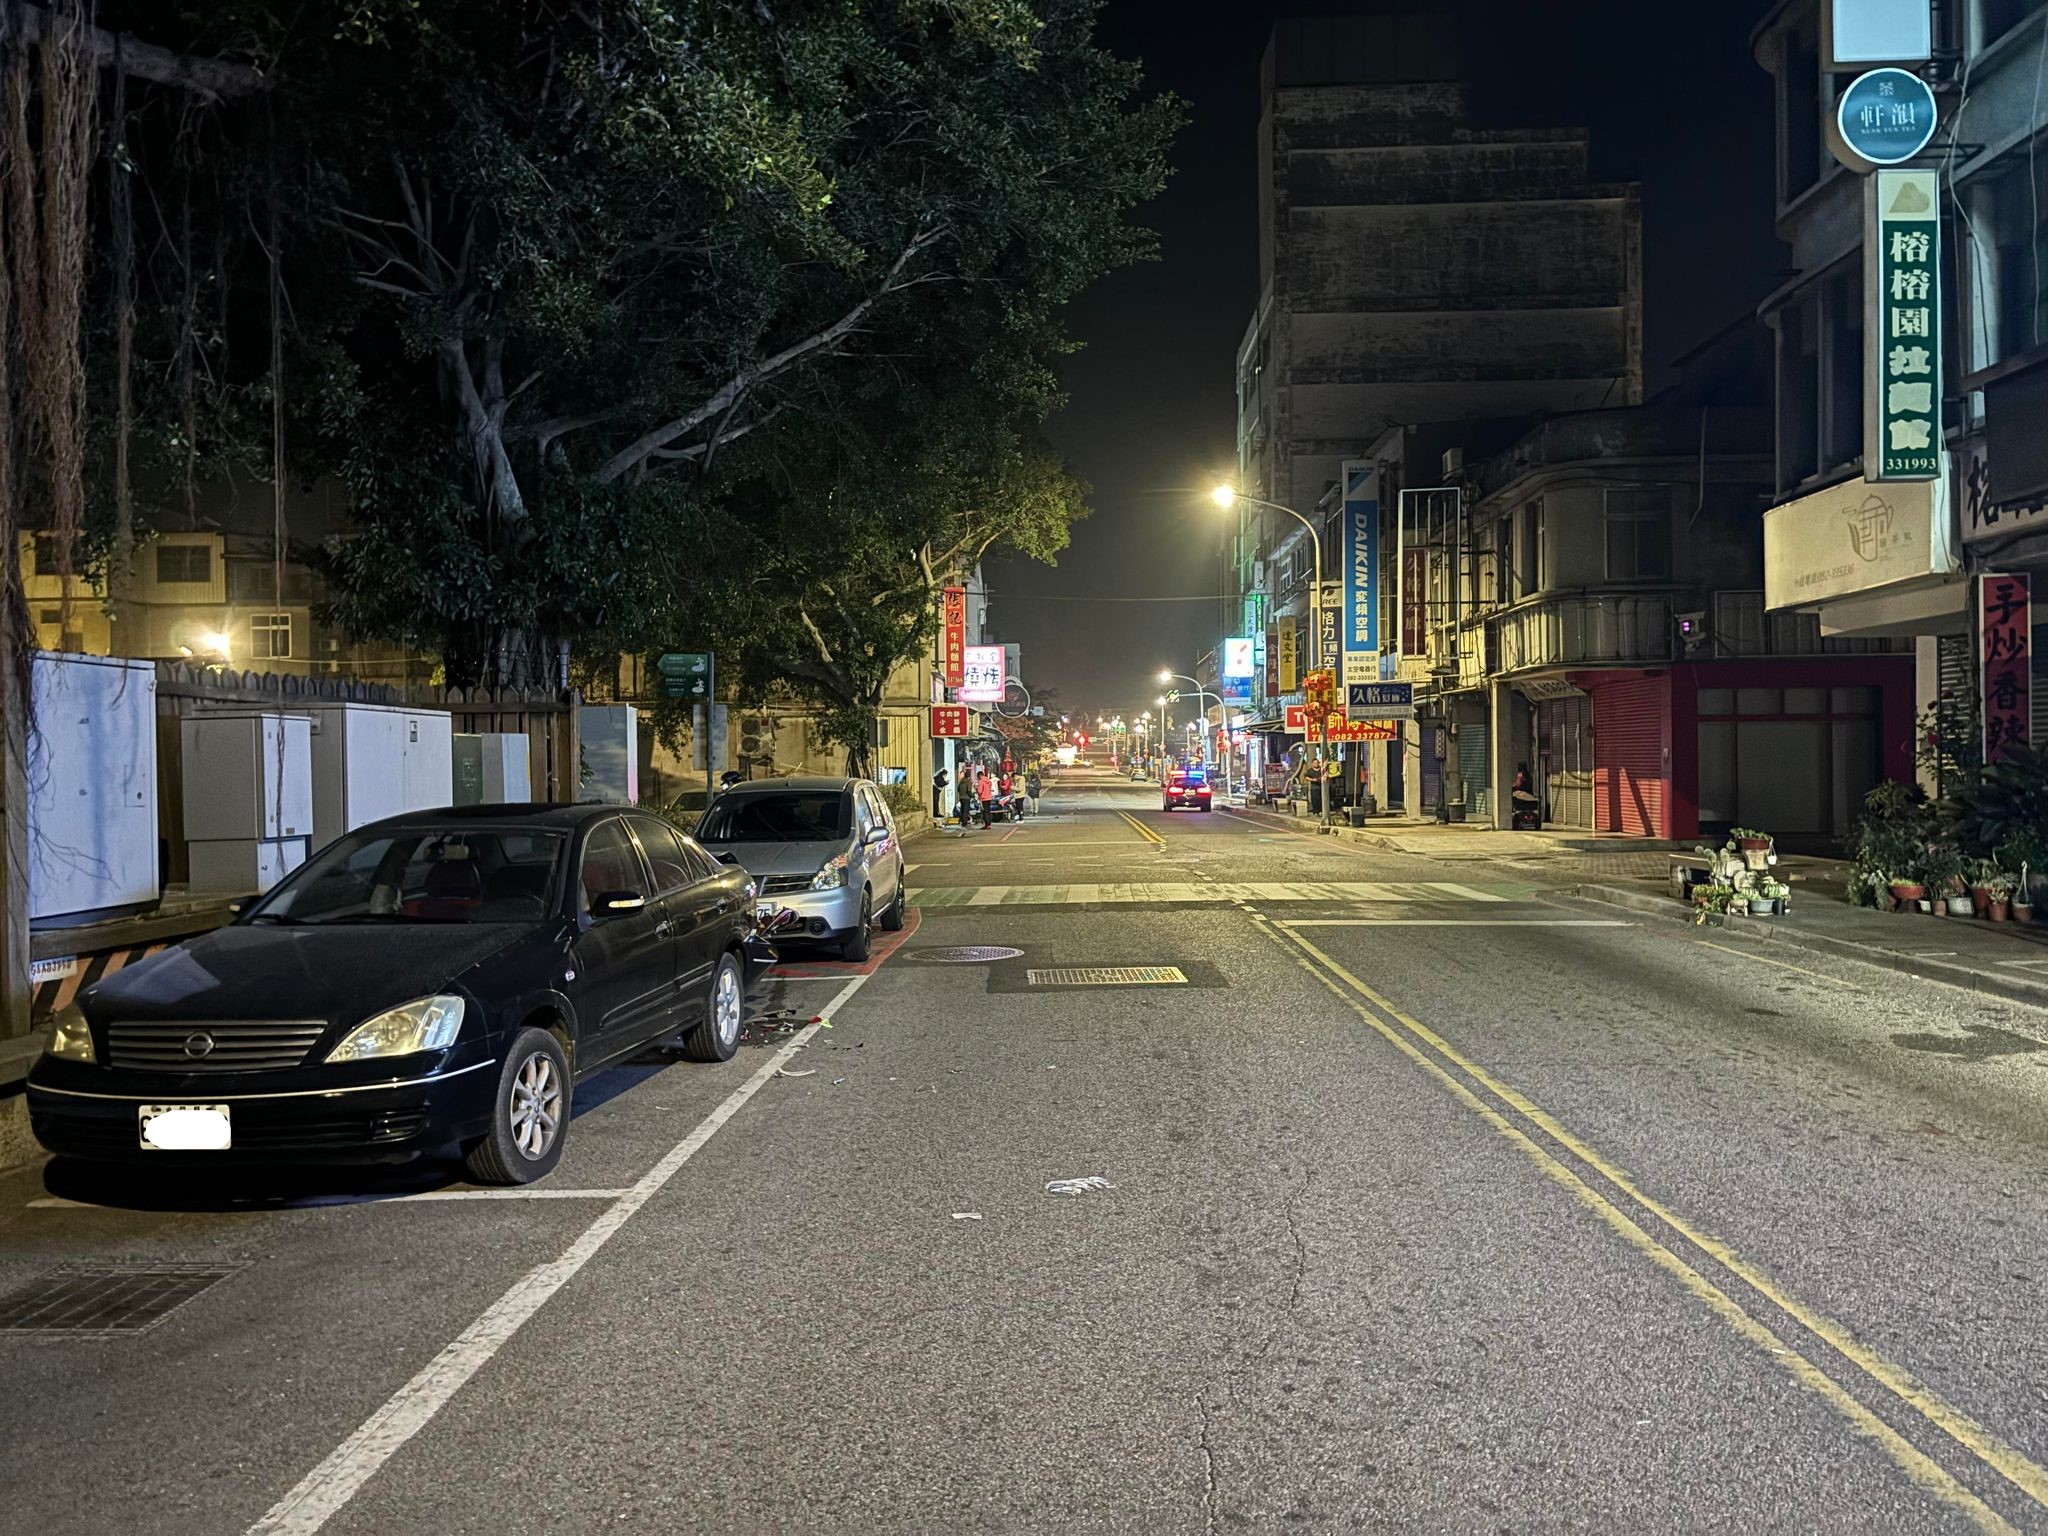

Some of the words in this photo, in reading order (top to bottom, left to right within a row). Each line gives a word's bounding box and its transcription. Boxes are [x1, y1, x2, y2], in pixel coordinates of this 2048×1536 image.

[1886, 457, 1937, 470] 331993
[1355, 513, 1369, 588] DAIKIN
[965, 666, 999, 687] 燒烤
[1352, 687, 1381, 703] 久格
[1356, 732, 1391, 740] 337877
